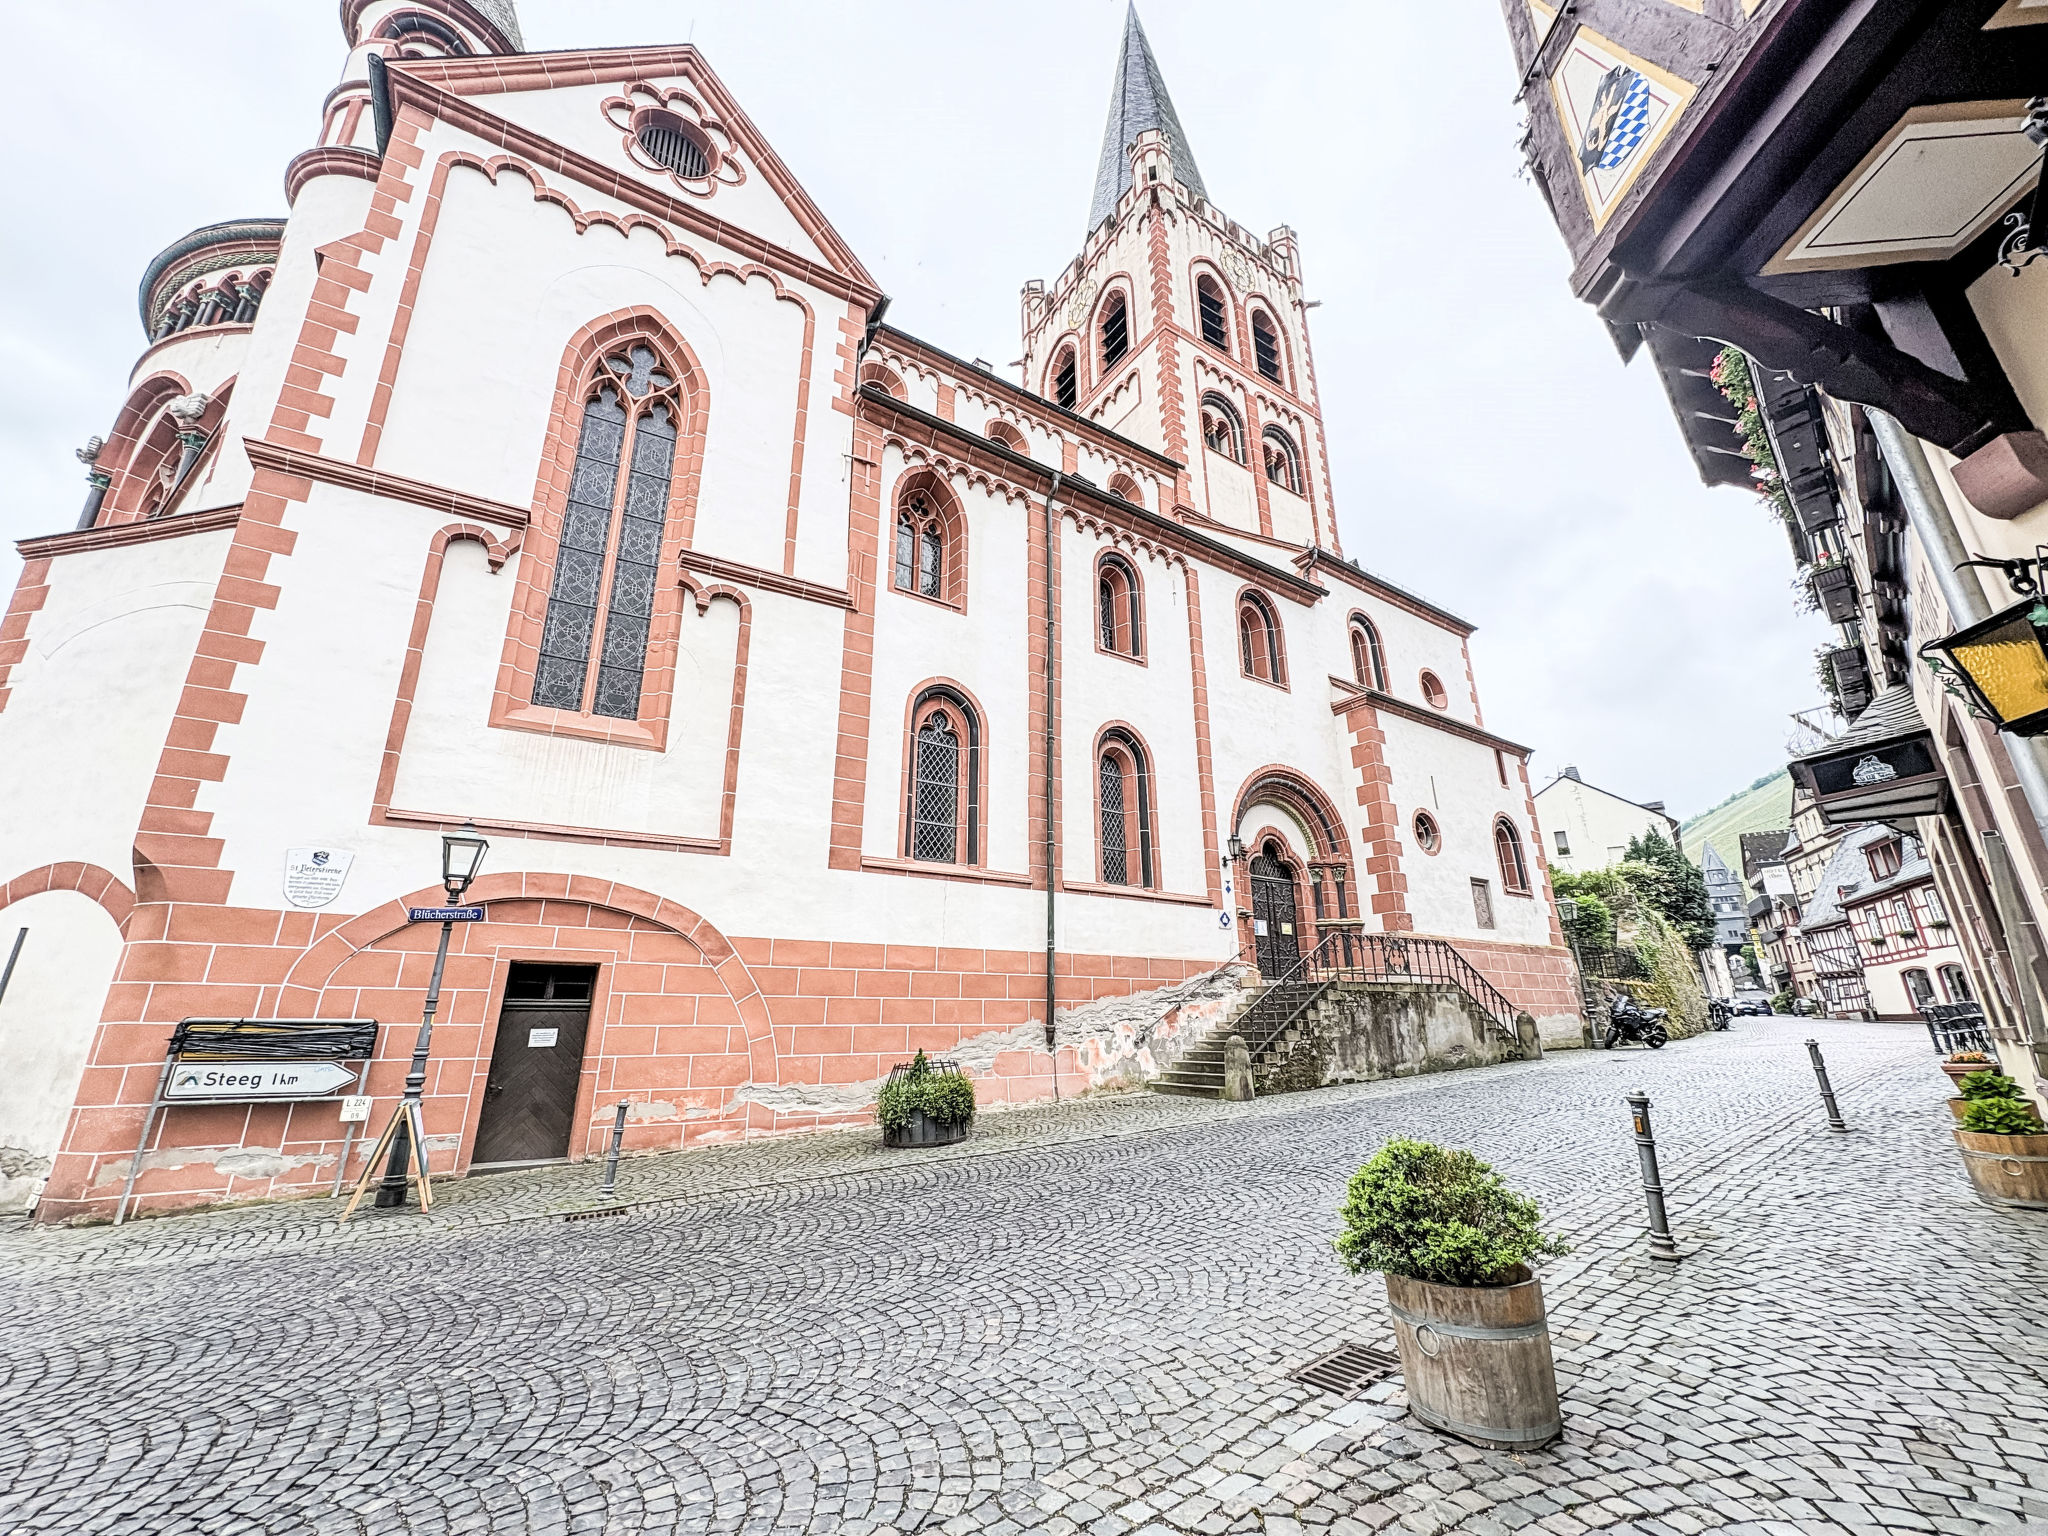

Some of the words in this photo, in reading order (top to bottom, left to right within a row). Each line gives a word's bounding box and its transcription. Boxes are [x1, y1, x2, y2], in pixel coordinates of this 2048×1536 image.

[413, 909, 478, 919] Blücherstraße
[203, 1072, 262, 1089] Steeg
[272, 1073, 278, 1085] 1
[280, 1073, 298, 1085] km
[346, 1099, 351, 1107] L
[354, 1098, 366, 1107] 224
